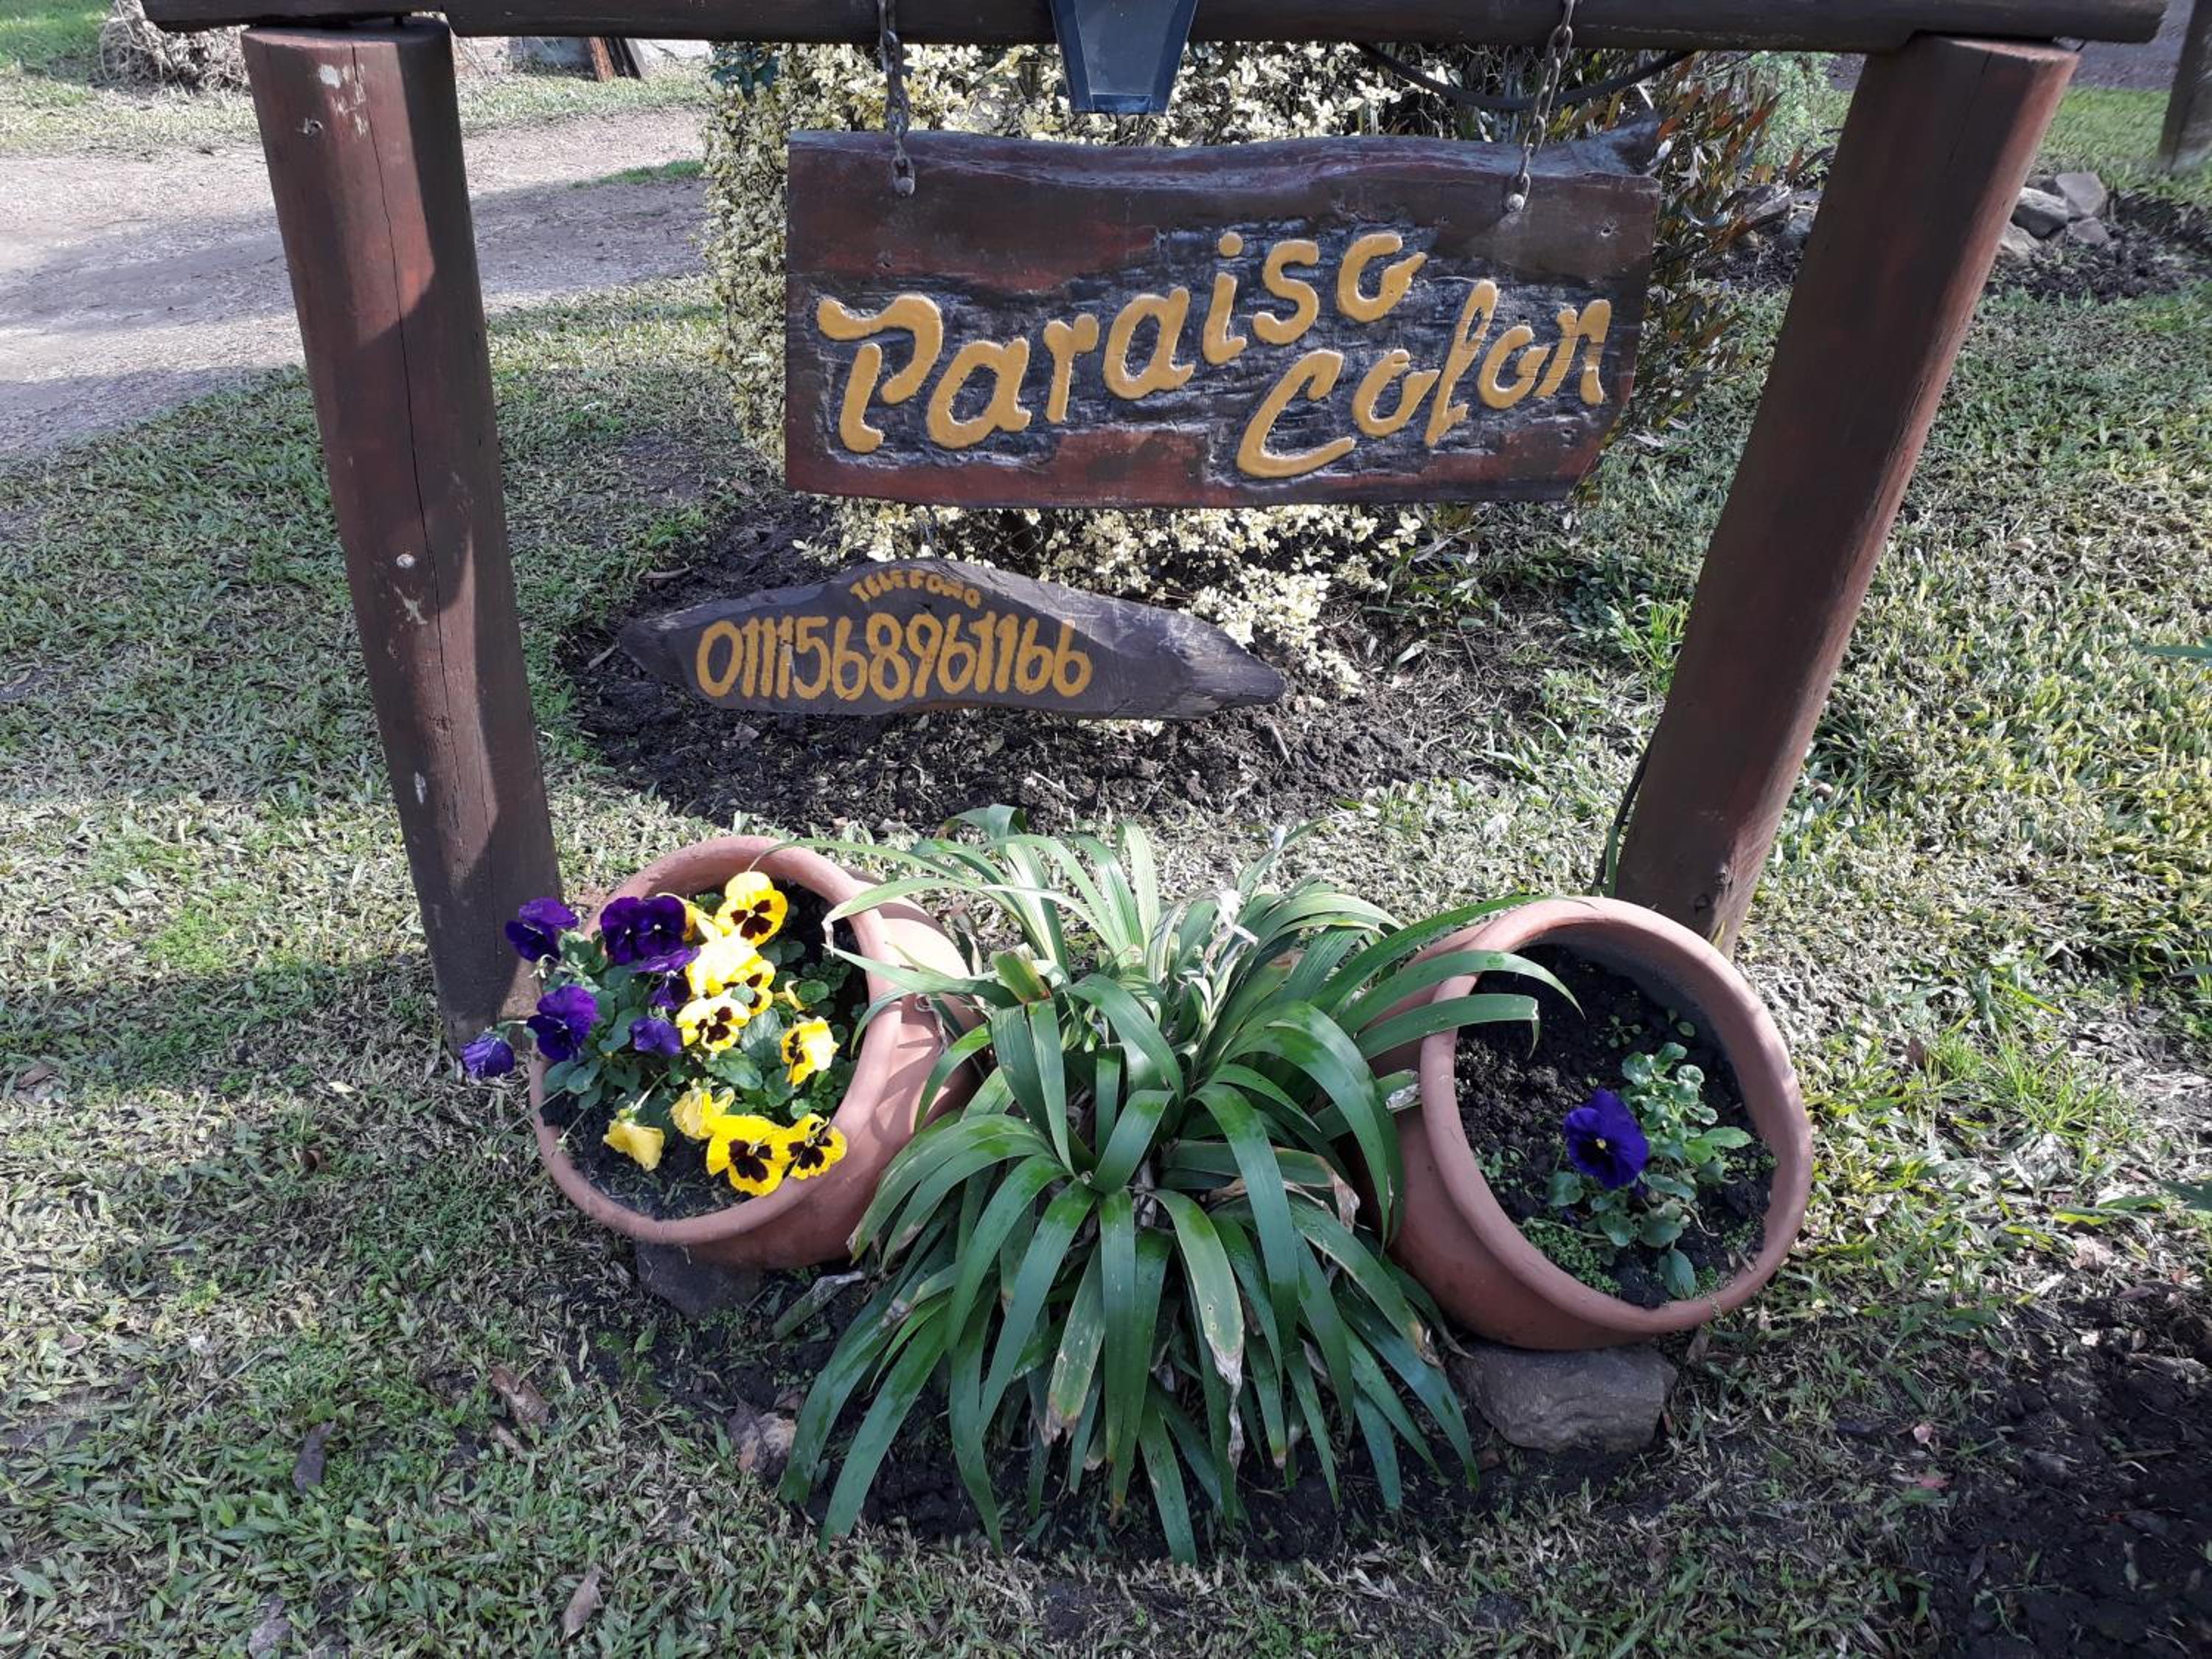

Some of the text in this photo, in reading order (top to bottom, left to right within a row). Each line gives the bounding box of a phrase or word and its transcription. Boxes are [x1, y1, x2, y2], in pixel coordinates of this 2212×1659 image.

[817, 230, 1427, 453] Paraiso
[1237, 278, 1612, 479] Colon
[696, 611, 1093, 701] 0111568961166
